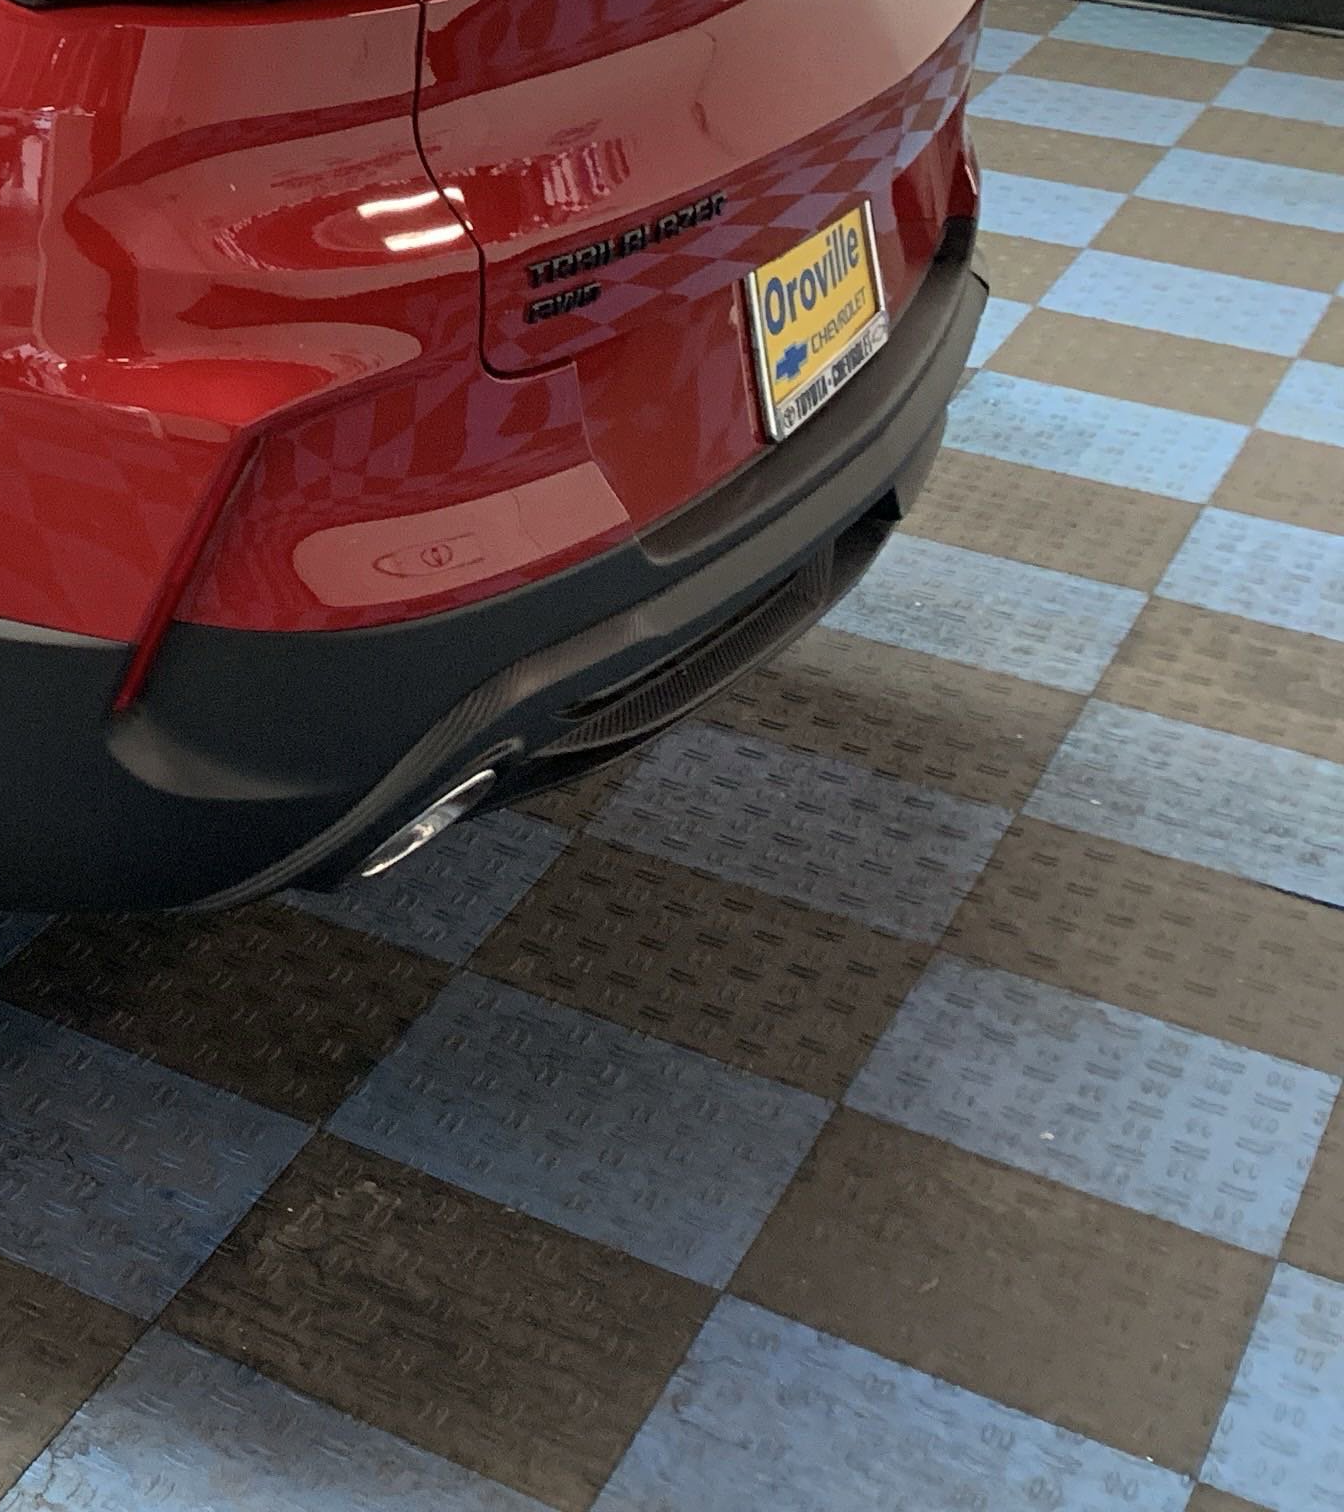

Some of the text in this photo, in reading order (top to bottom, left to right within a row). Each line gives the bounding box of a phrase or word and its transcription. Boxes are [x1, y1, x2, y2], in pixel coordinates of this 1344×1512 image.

[764, 223, 861, 336] Oroville
[811, 286, 867, 355] CHEVROLET
[795, 330, 873, 421] TOYOTA CHEVROLET
